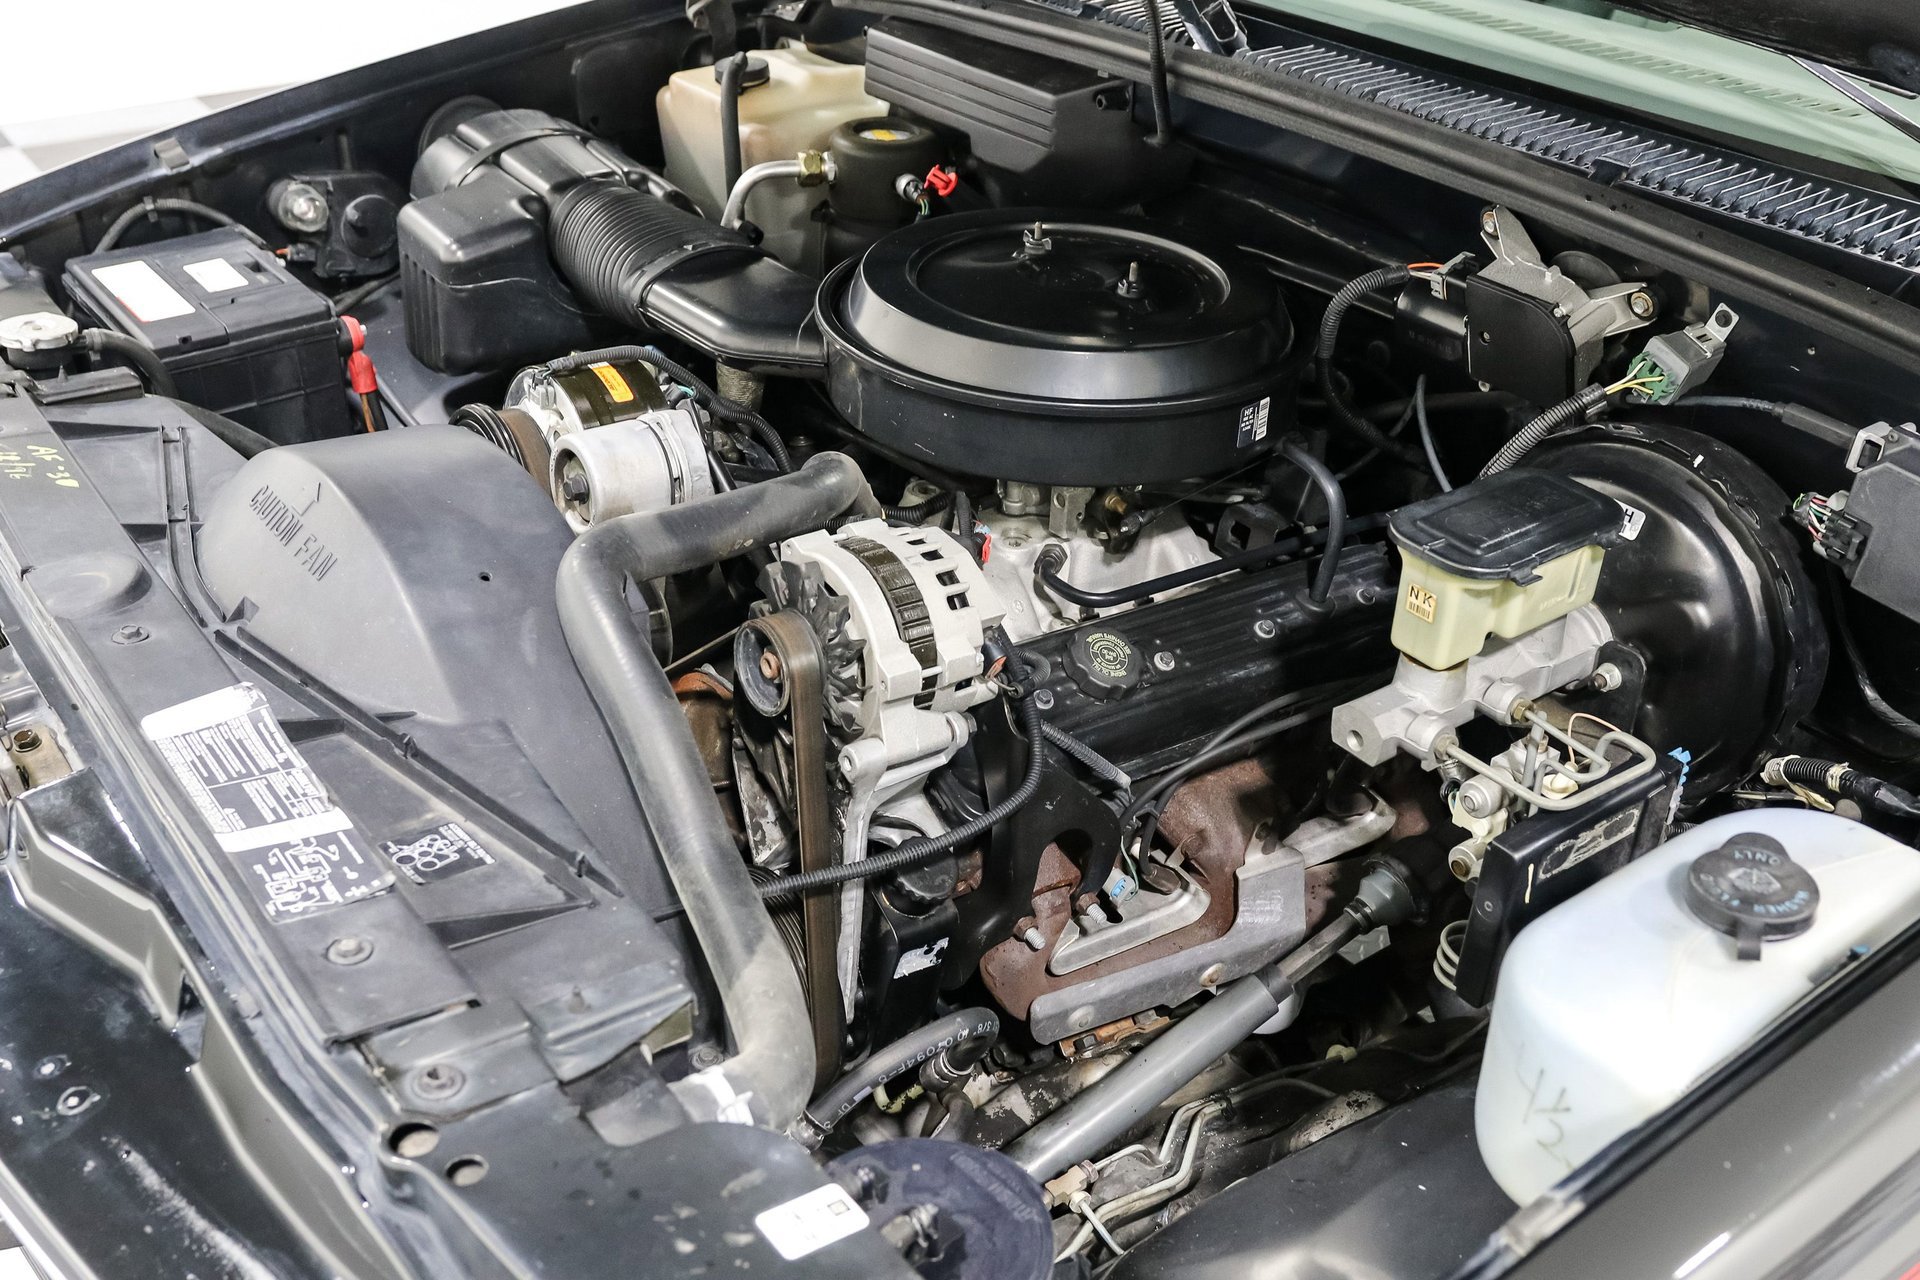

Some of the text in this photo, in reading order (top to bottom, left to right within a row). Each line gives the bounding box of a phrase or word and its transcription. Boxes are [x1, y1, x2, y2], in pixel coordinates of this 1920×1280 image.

[249, 484, 338, 581] CAUTION FAN
[1733, 849, 1782, 866] ONLY
